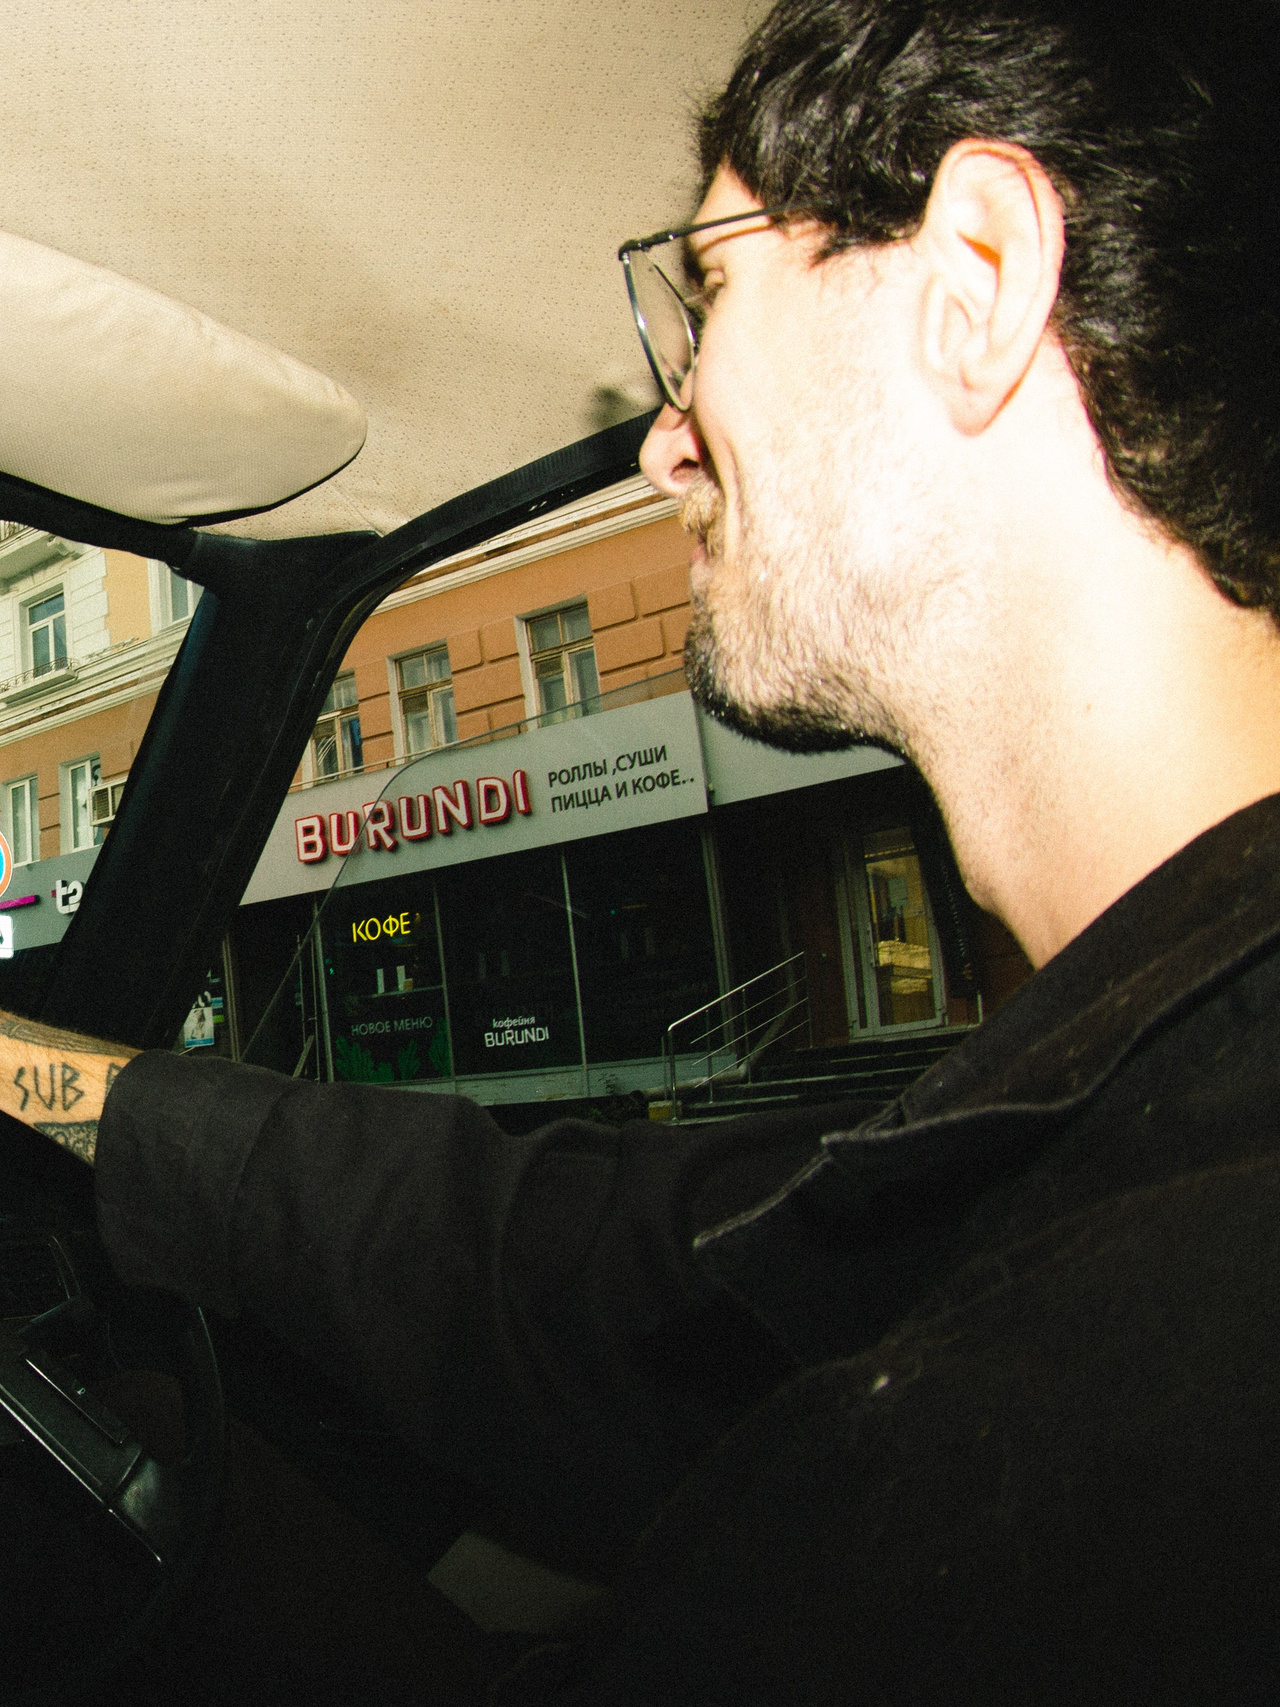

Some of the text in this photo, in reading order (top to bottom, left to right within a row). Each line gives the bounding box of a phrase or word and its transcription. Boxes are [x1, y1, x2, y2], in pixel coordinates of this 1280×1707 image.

[548, 759, 607, 788] РОЛЛЫ
[551, 786, 612, 813] ПИЦЦА
[616, 781, 628, 798] И
[295, 769, 531, 863] BURUNDI
[351, 911, 412, 943] КОФЕ
[351, 1016, 433, 1036] НОВОЕ МЕНЮ
[484, 1026, 550, 1048] BURUNDI
[14, 1061, 86, 1111] SUB
